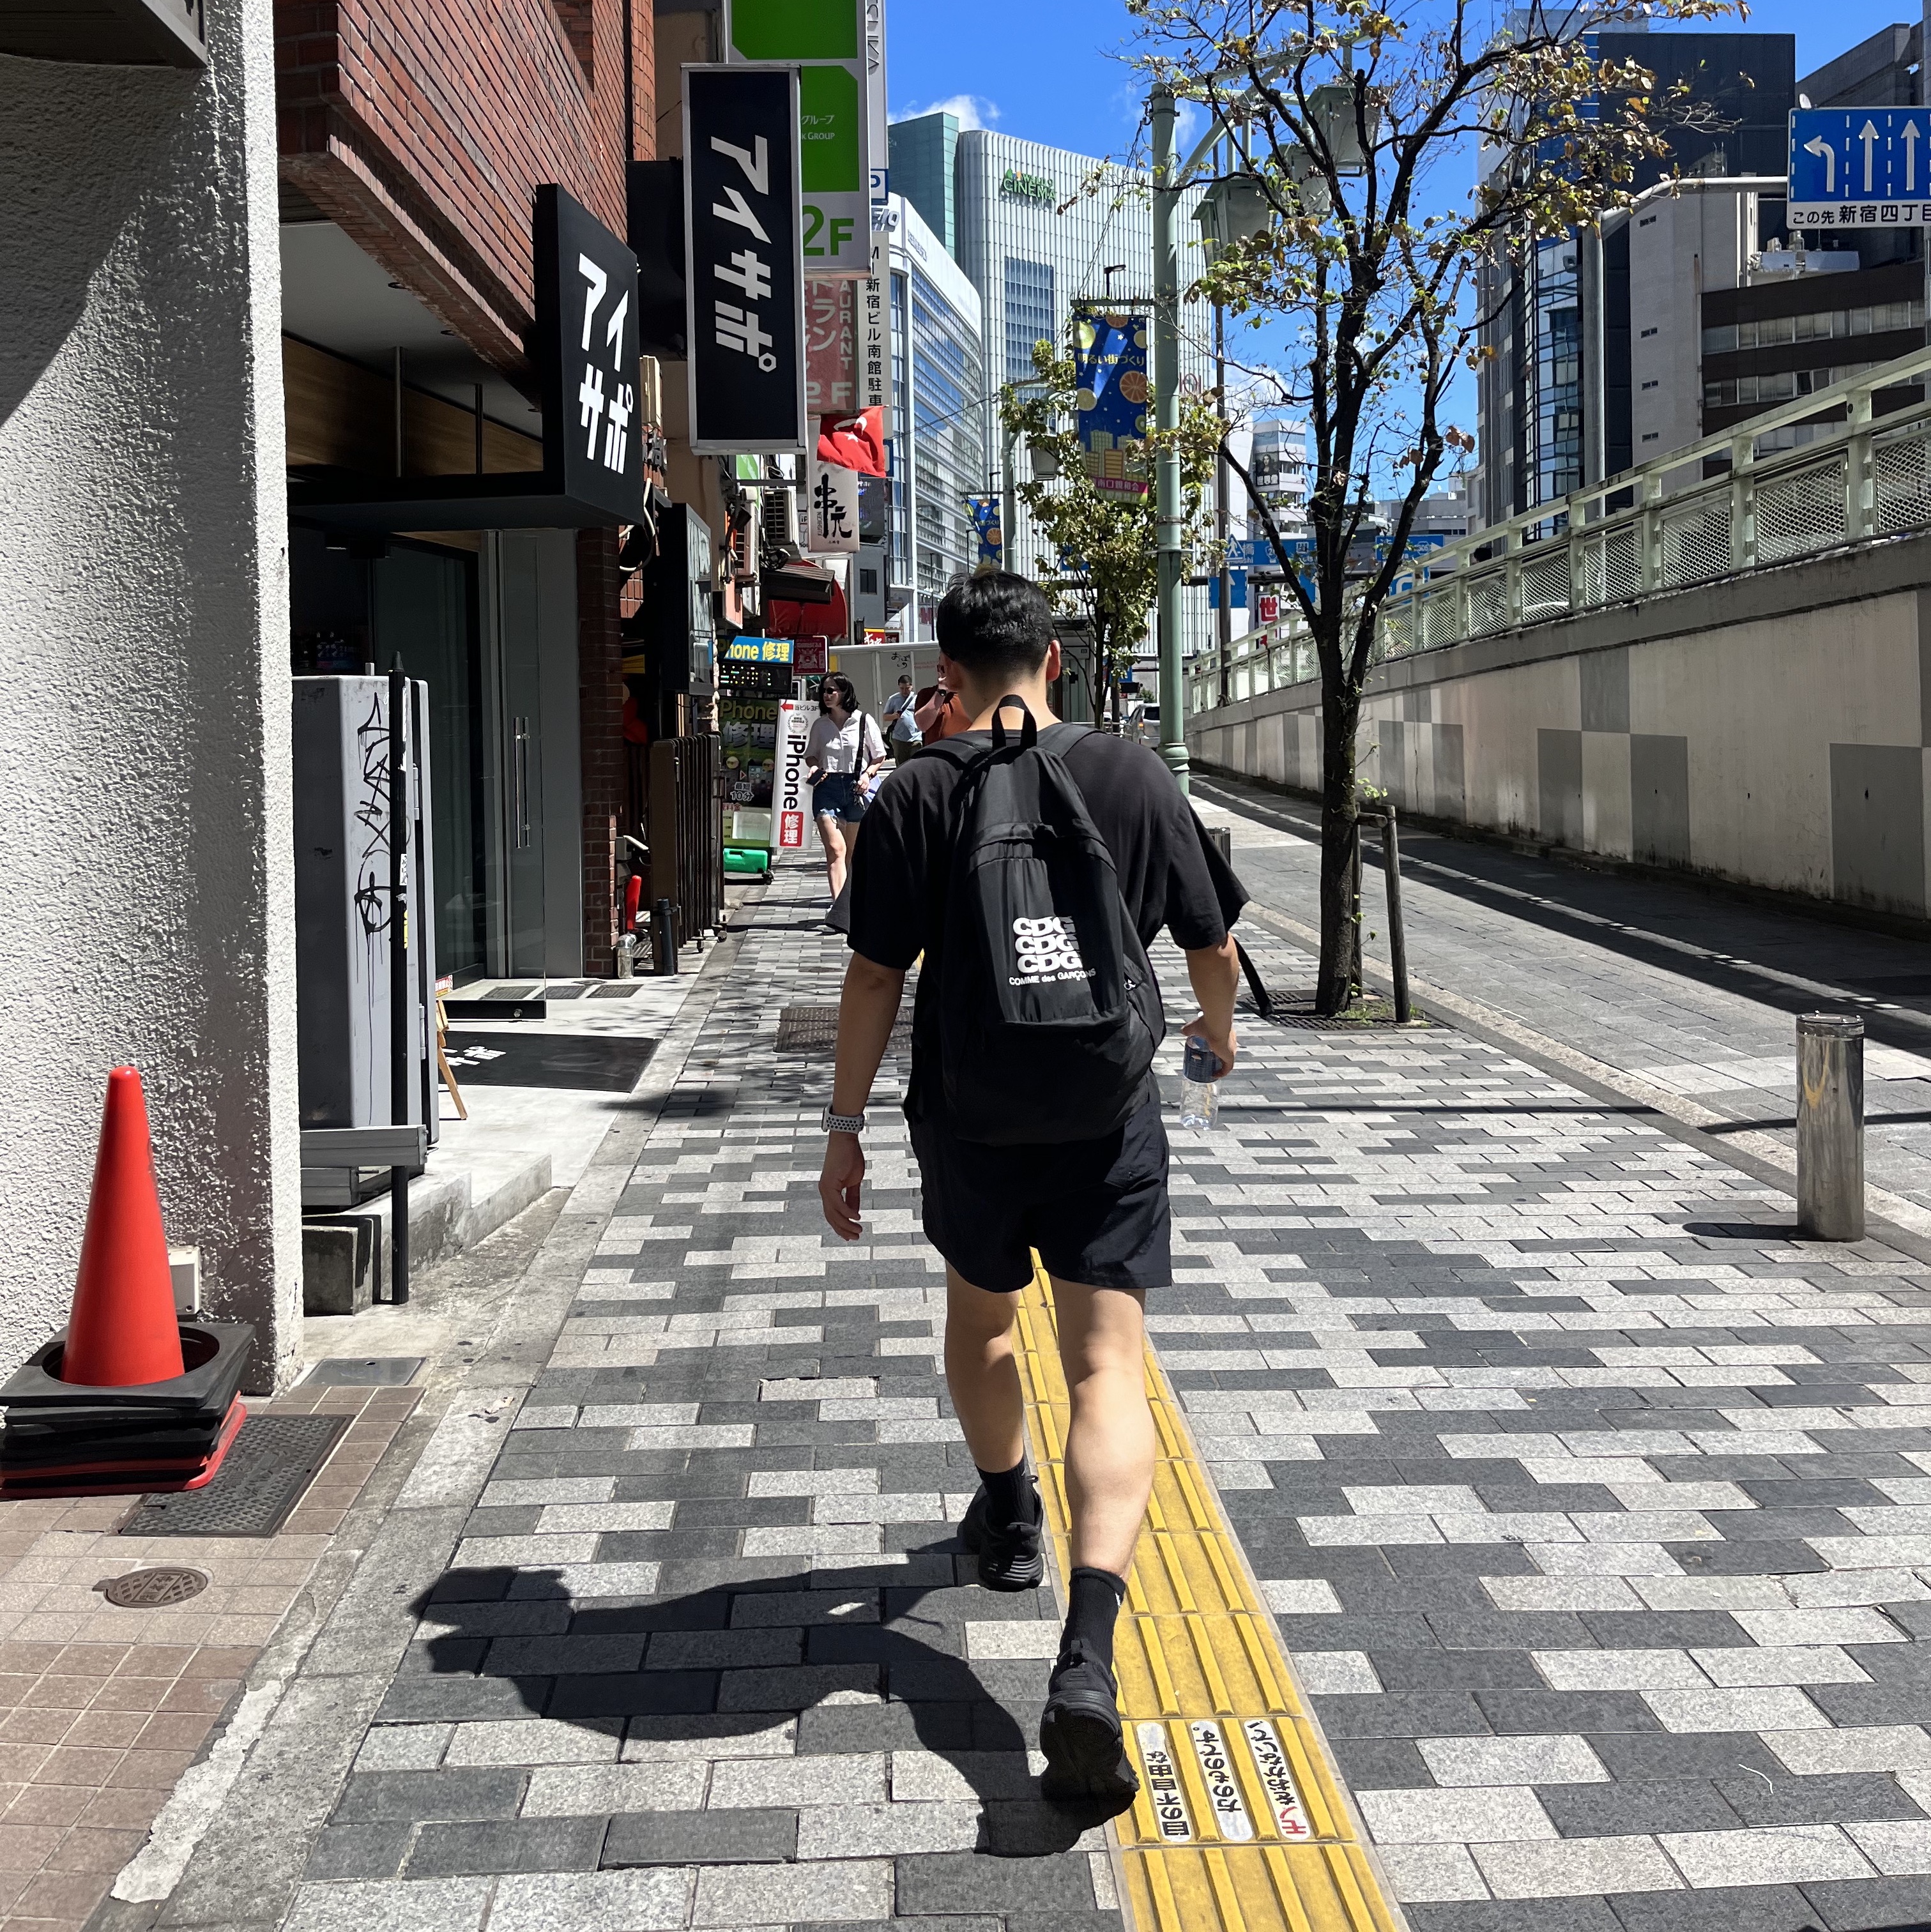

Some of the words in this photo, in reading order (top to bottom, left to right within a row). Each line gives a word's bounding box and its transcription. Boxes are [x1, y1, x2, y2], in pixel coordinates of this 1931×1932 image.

[808, 132, 836, 141] GROUP
[1003, 178, 1057, 201] CINEMA
[1792, 211, 1835, 224] この先
[802, 205, 855, 255] 2F
[710, 134, 777, 372] アイサポ
[579, 252, 629, 372] アイ
[1078, 352, 1145, 367] 明るい街づくり
[579, 363, 634, 475] サポ
[762, 641, 790, 662] 修理
[722, 721, 776, 749] 修理
[783, 734, 807, 810] iPhone
[730, 790, 754, 802] 10分
[783, 814, 799, 845] 修理
[1012, 917, 1076, 937] CDG
[1014, 933, 1080, 955] CDG
[1017, 951, 1083, 973] CDG
[1009, 975, 1040, 986] COMME
[1041, 974, 1057, 982] des
[1193, 1726, 1242, 1813] 方のものです。
[1146, 1751, 1191, 1836] 目の不自由な
